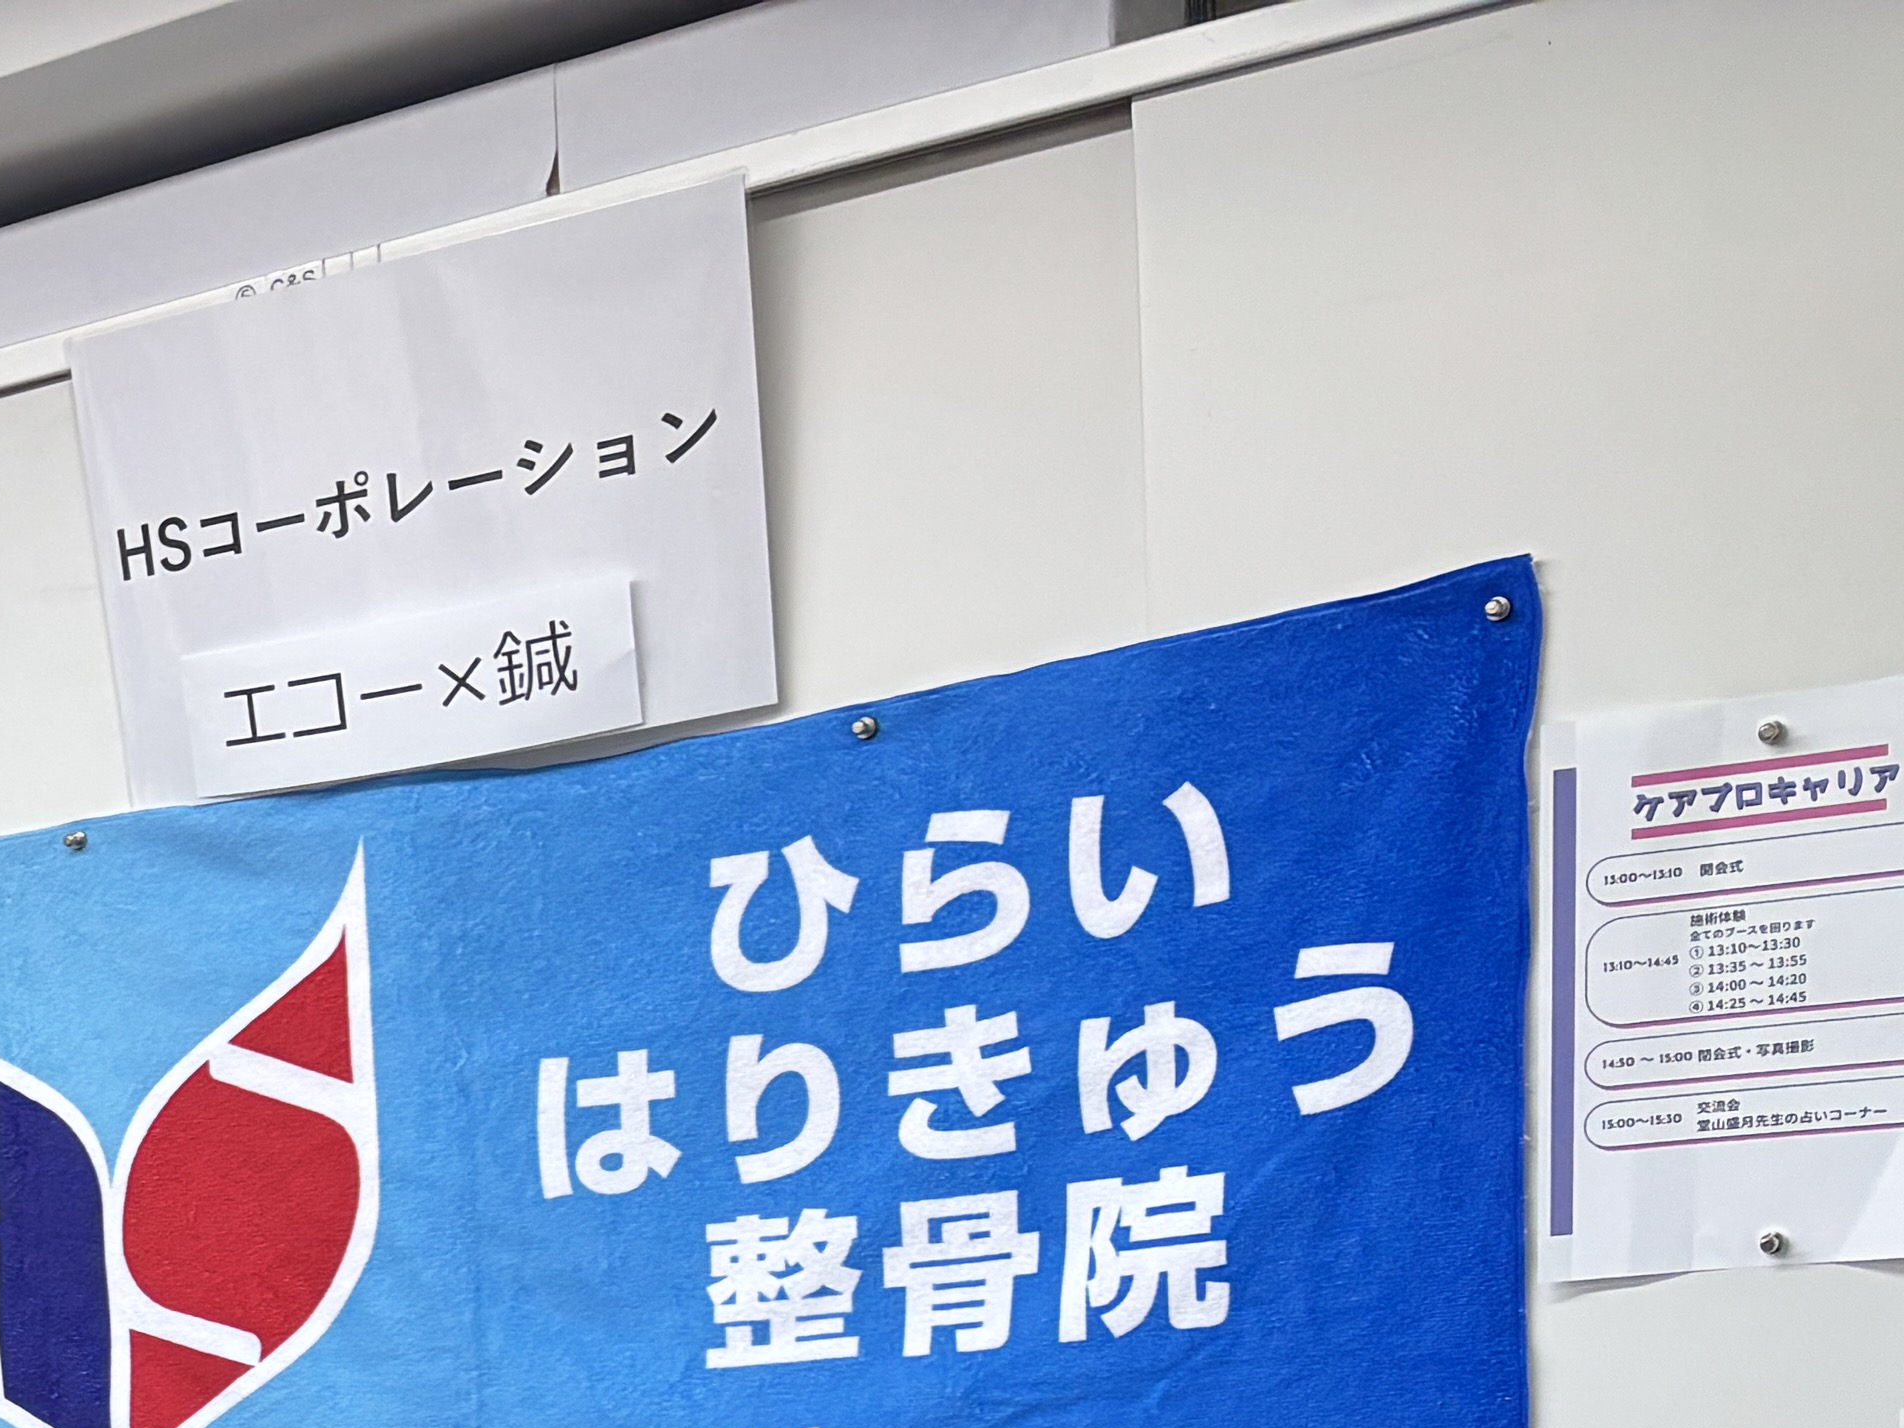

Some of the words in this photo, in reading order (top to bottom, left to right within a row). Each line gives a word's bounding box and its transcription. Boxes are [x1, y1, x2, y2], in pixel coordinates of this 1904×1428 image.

[117, 408, 718, 581] HSコーポレーション
[223, 619, 579, 747] エコー×鍼
[1633, 764, 1900, 822] ケアプロキャリア
[1699, 860, 1744, 876] 開会式
[709, 780, 1230, 993] ひらい
[1690, 909, 1746, 927] 施術体験
[1690, 919, 1815, 941] 全てのブースを回ります
[1708, 961, 1746, 975] 13:35
[1769, 955, 1807, 970] 13:55
[1708, 979, 1746, 994] 14:00
[1768, 973, 1807, 988] 14:20
[1708, 997, 1746, 1012] 14:25
[1768, 991, 1807, 1007] 14:45
[1659, 1051, 1693, 1064] 15:00
[537, 941, 1414, 1200] はりきゅう
[1697, 1099, 1741, 1114] 交流会
[705, 1166, 1230, 1370] 整骨院
